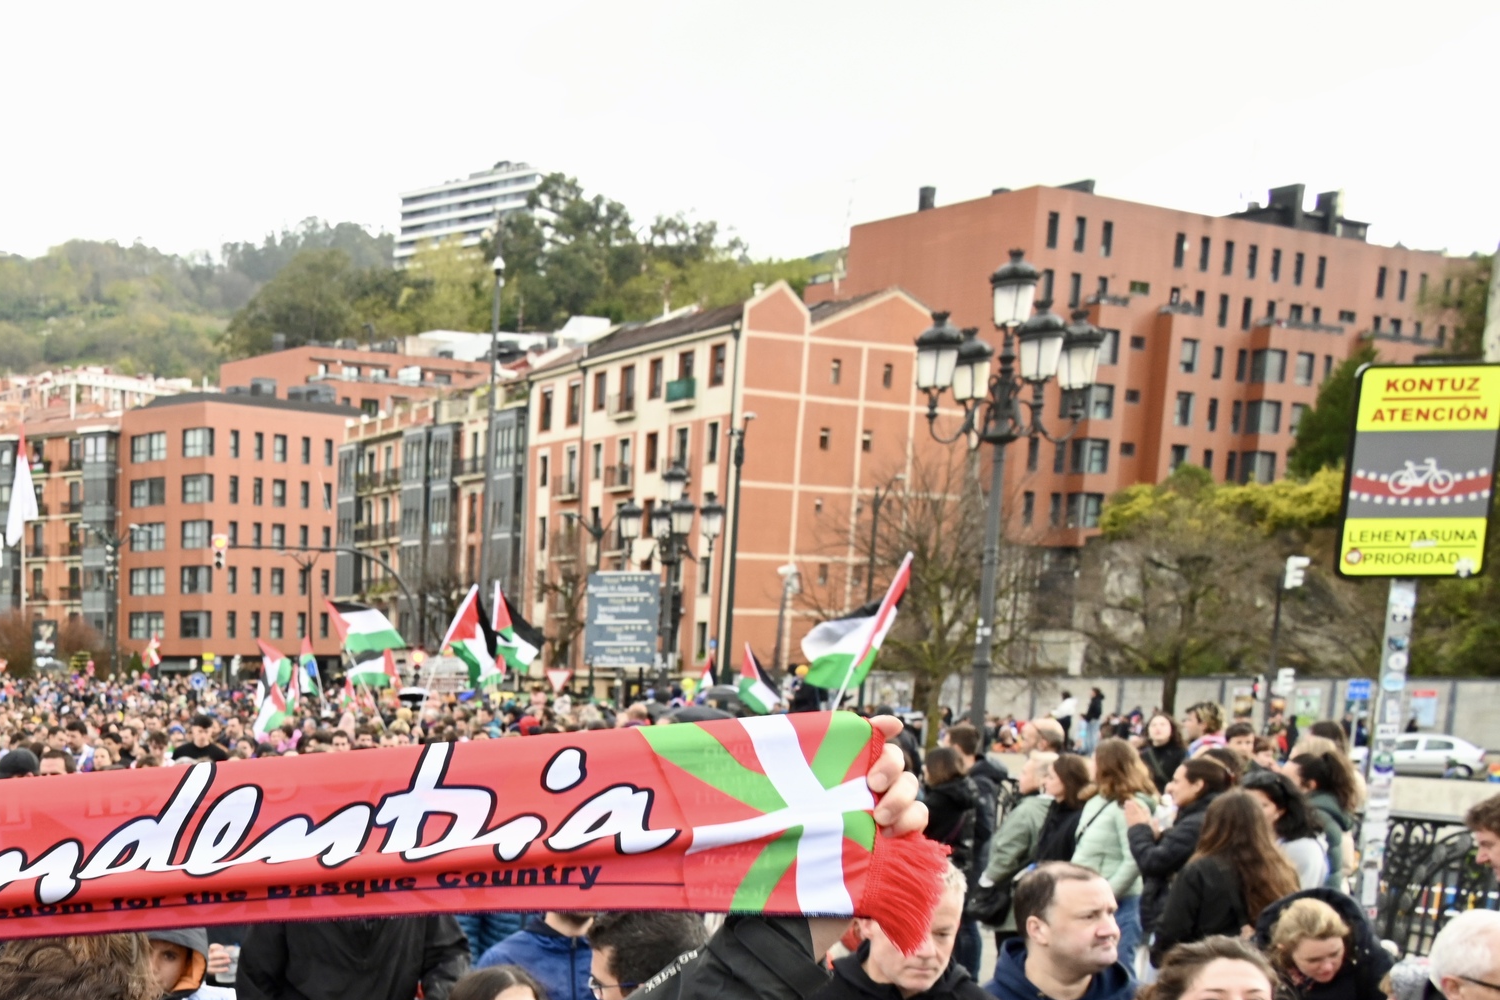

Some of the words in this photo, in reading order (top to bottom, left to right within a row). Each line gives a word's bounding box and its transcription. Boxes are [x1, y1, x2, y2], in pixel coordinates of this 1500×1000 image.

[1385, 377, 1481, 393] KONTUZ
[1371, 403, 1489, 422] ATENCIÓN
[1348, 530, 1478, 543] LEHENTASUNA
[1363, 552, 1460, 565] PRIORIDAD
[112, 897, 161, 911] for
[185, 889, 248, 904] the
[267, 876, 417, 898] Basque
[436, 865, 602, 890] Country
